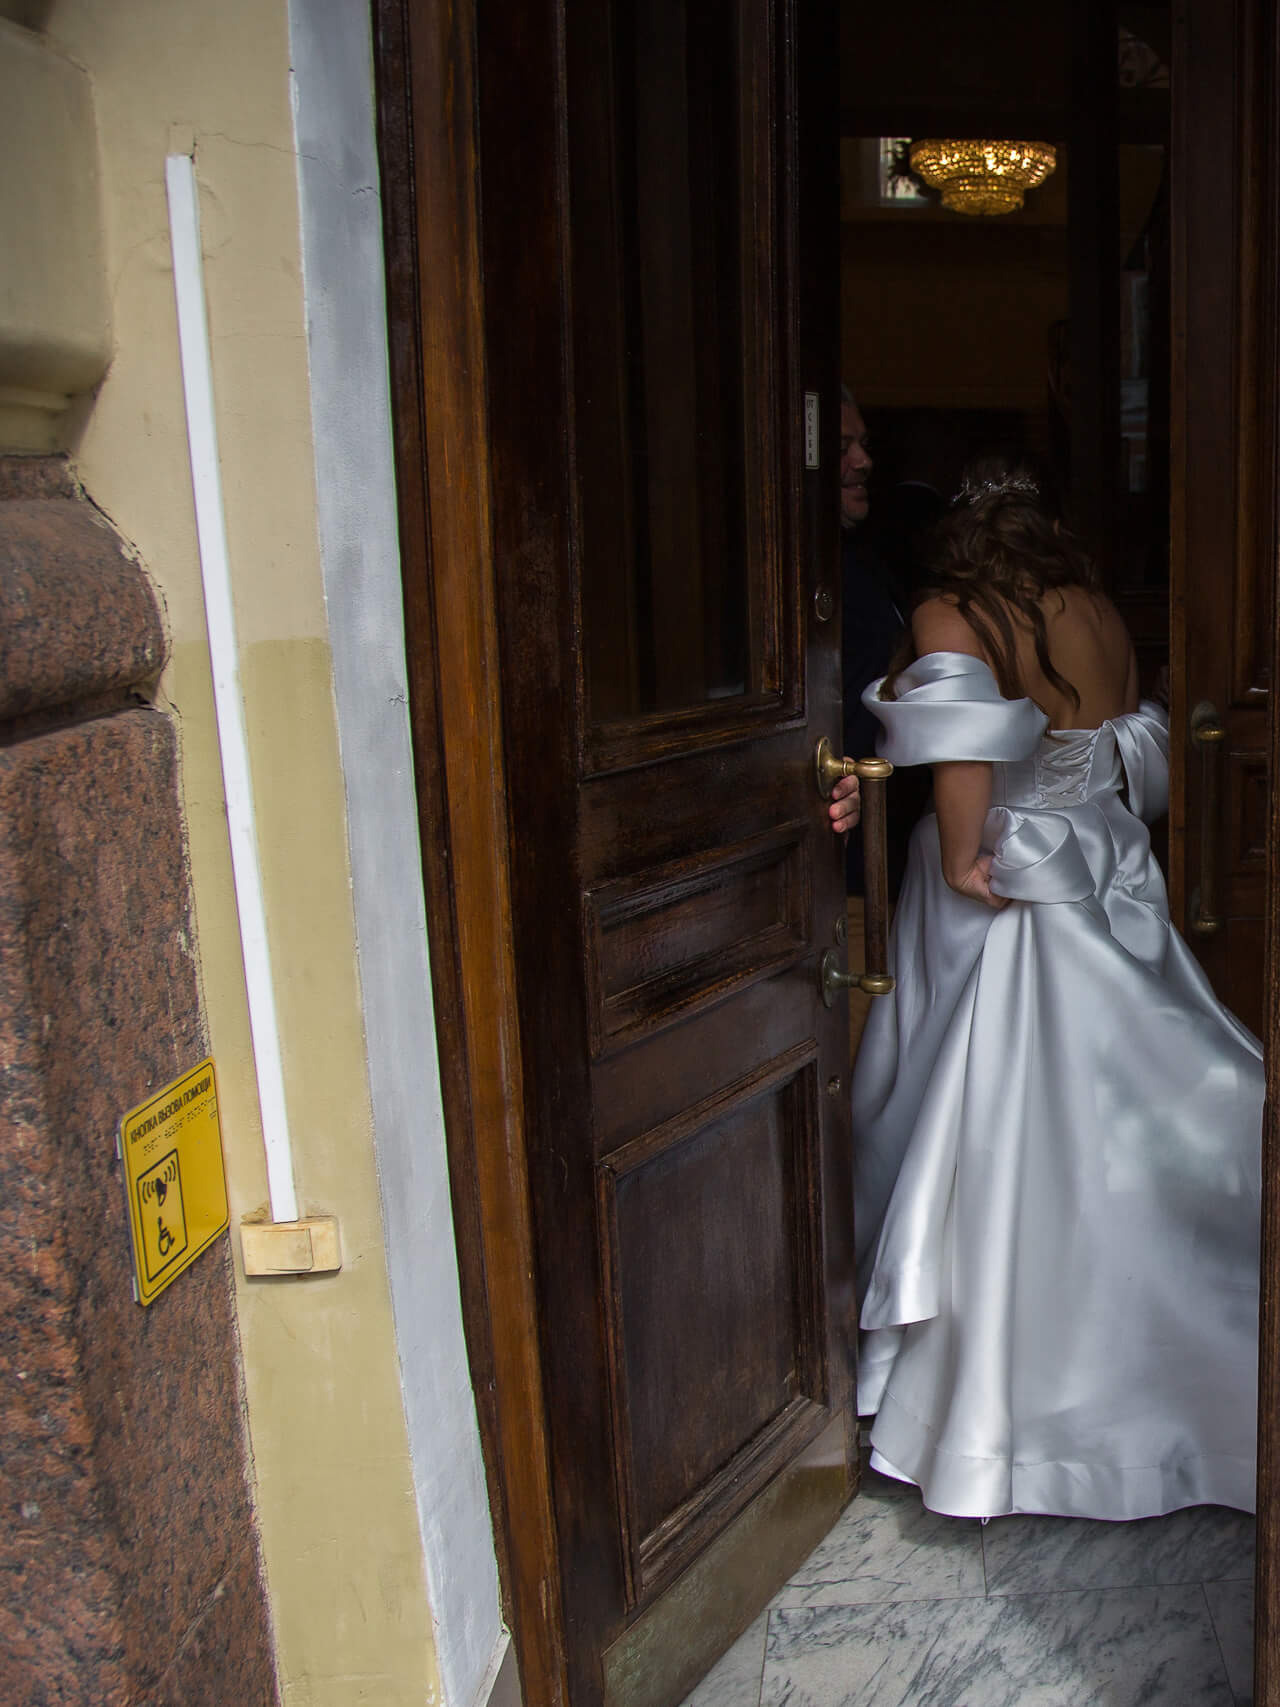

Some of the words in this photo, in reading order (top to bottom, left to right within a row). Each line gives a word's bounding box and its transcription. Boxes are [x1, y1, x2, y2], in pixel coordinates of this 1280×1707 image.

[130, 1115, 158, 1144] КНОПКА
[158, 1097, 182, 1125] ВЫЗОВА
[183, 1075, 211, 1105] ПОМОЩИ
